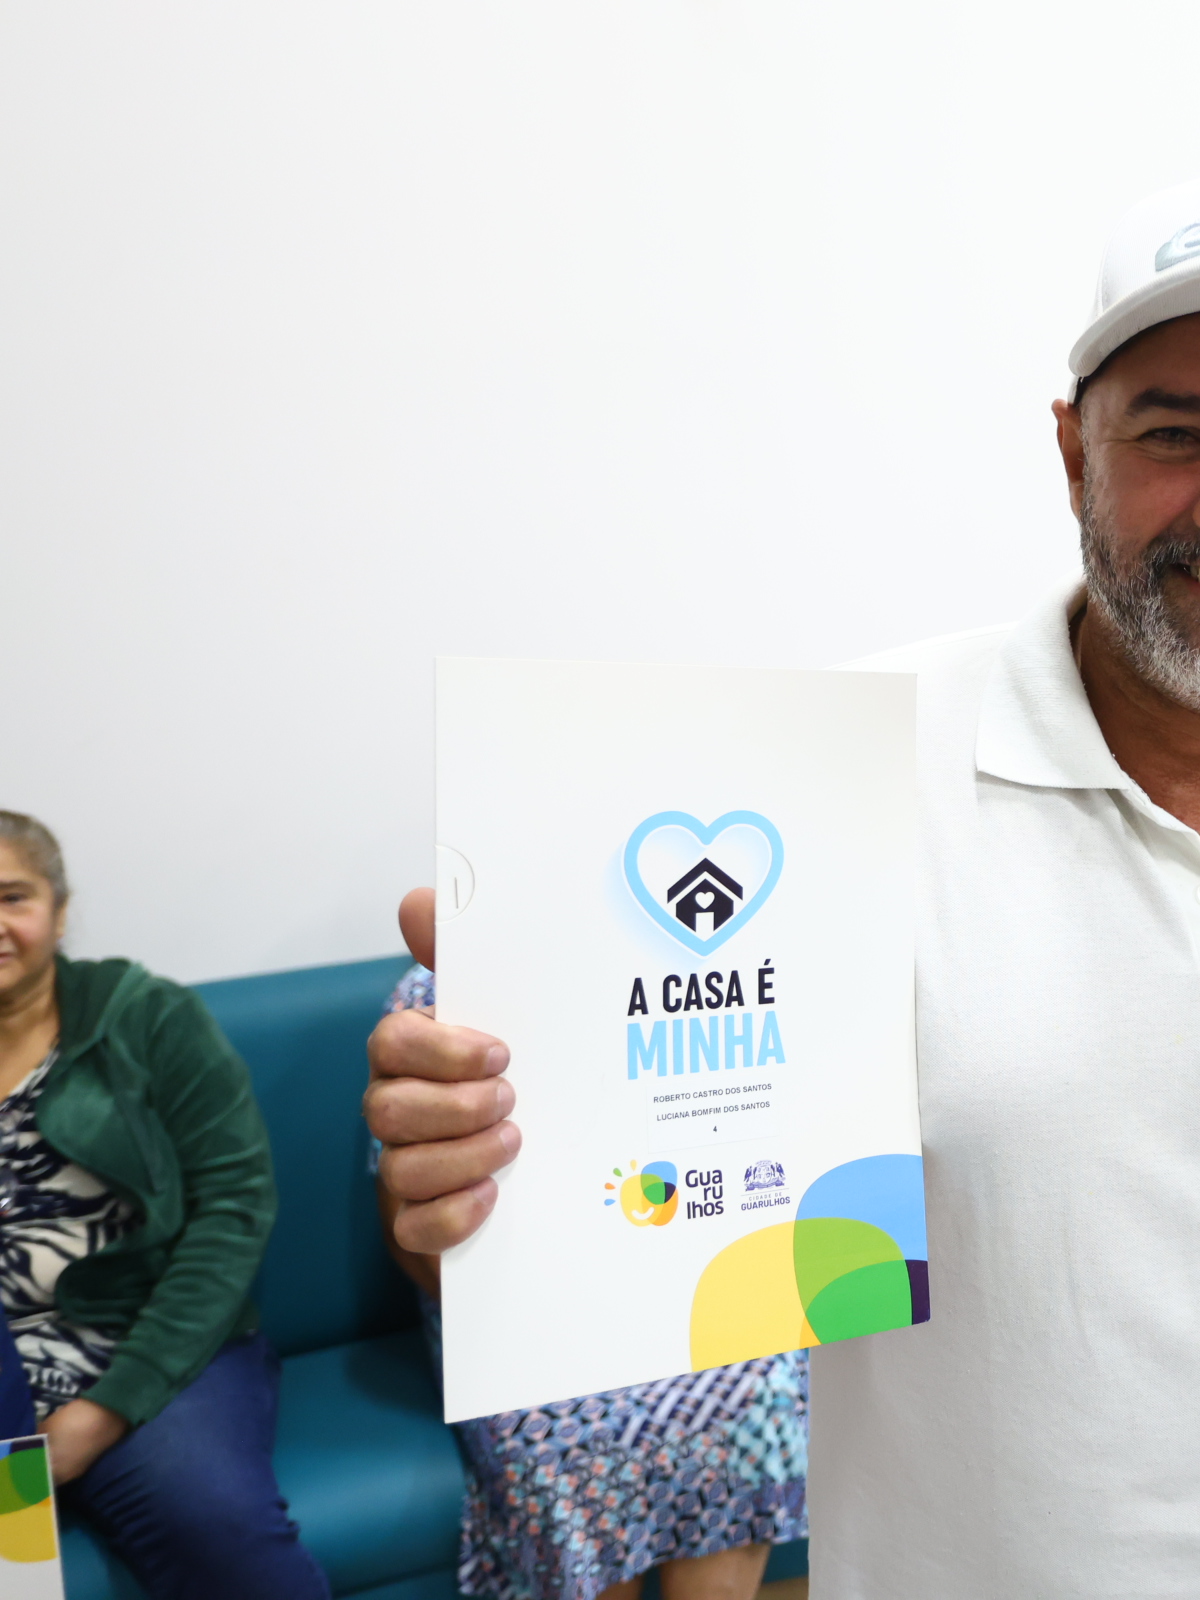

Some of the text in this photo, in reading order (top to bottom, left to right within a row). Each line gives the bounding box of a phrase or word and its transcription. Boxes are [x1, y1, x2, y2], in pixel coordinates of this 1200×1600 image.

[627, 958, 775, 1016] A CASA É
[627, 1010, 786, 1080] MINHA
[653, 1083, 772, 1104] ROBERTO CASTRO DOS SANTOS
[656, 1101, 771, 1121] LUCIANA BOMFIM DOS SANTOS
[685, 1169, 723, 1188] Gua
[703, 1185, 723, 1201] ru
[741, 1196, 791, 1211] GUARULHOS
